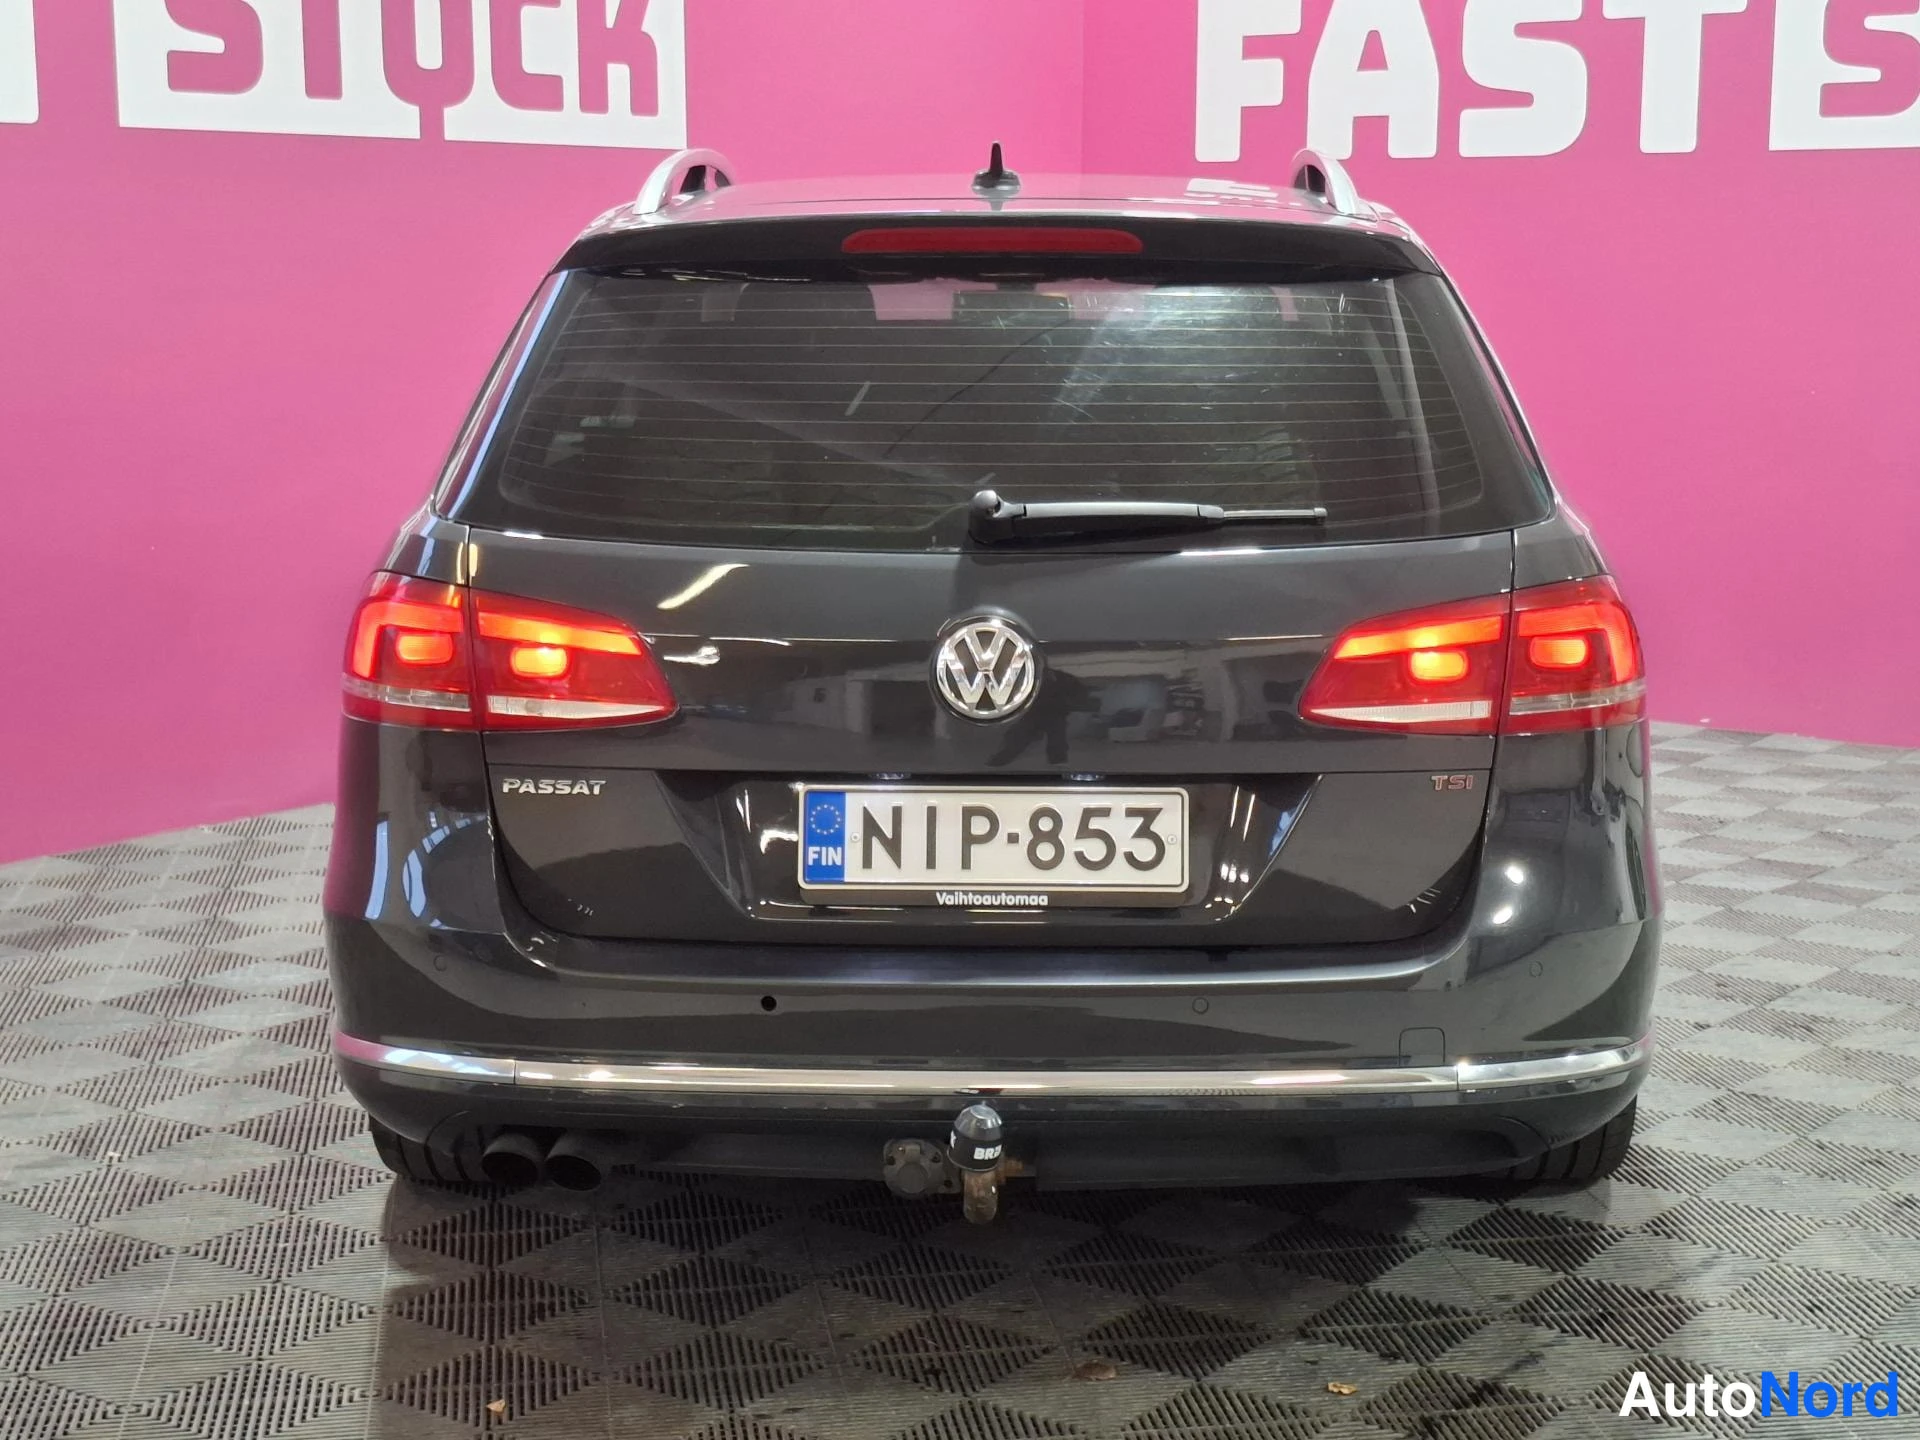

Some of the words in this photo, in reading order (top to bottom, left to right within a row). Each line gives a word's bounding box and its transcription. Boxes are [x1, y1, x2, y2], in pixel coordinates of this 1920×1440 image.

[1195, 0, 1748, 162] FAST
[502, 778, 606, 795] PASSAT
[1431, 774, 1474, 791] TSI
[861, 805, 1166, 872] NIP-853
[807, 846, 842, 866] FIN
[935, 891, 1049, 906] Vaihtoautomaa
